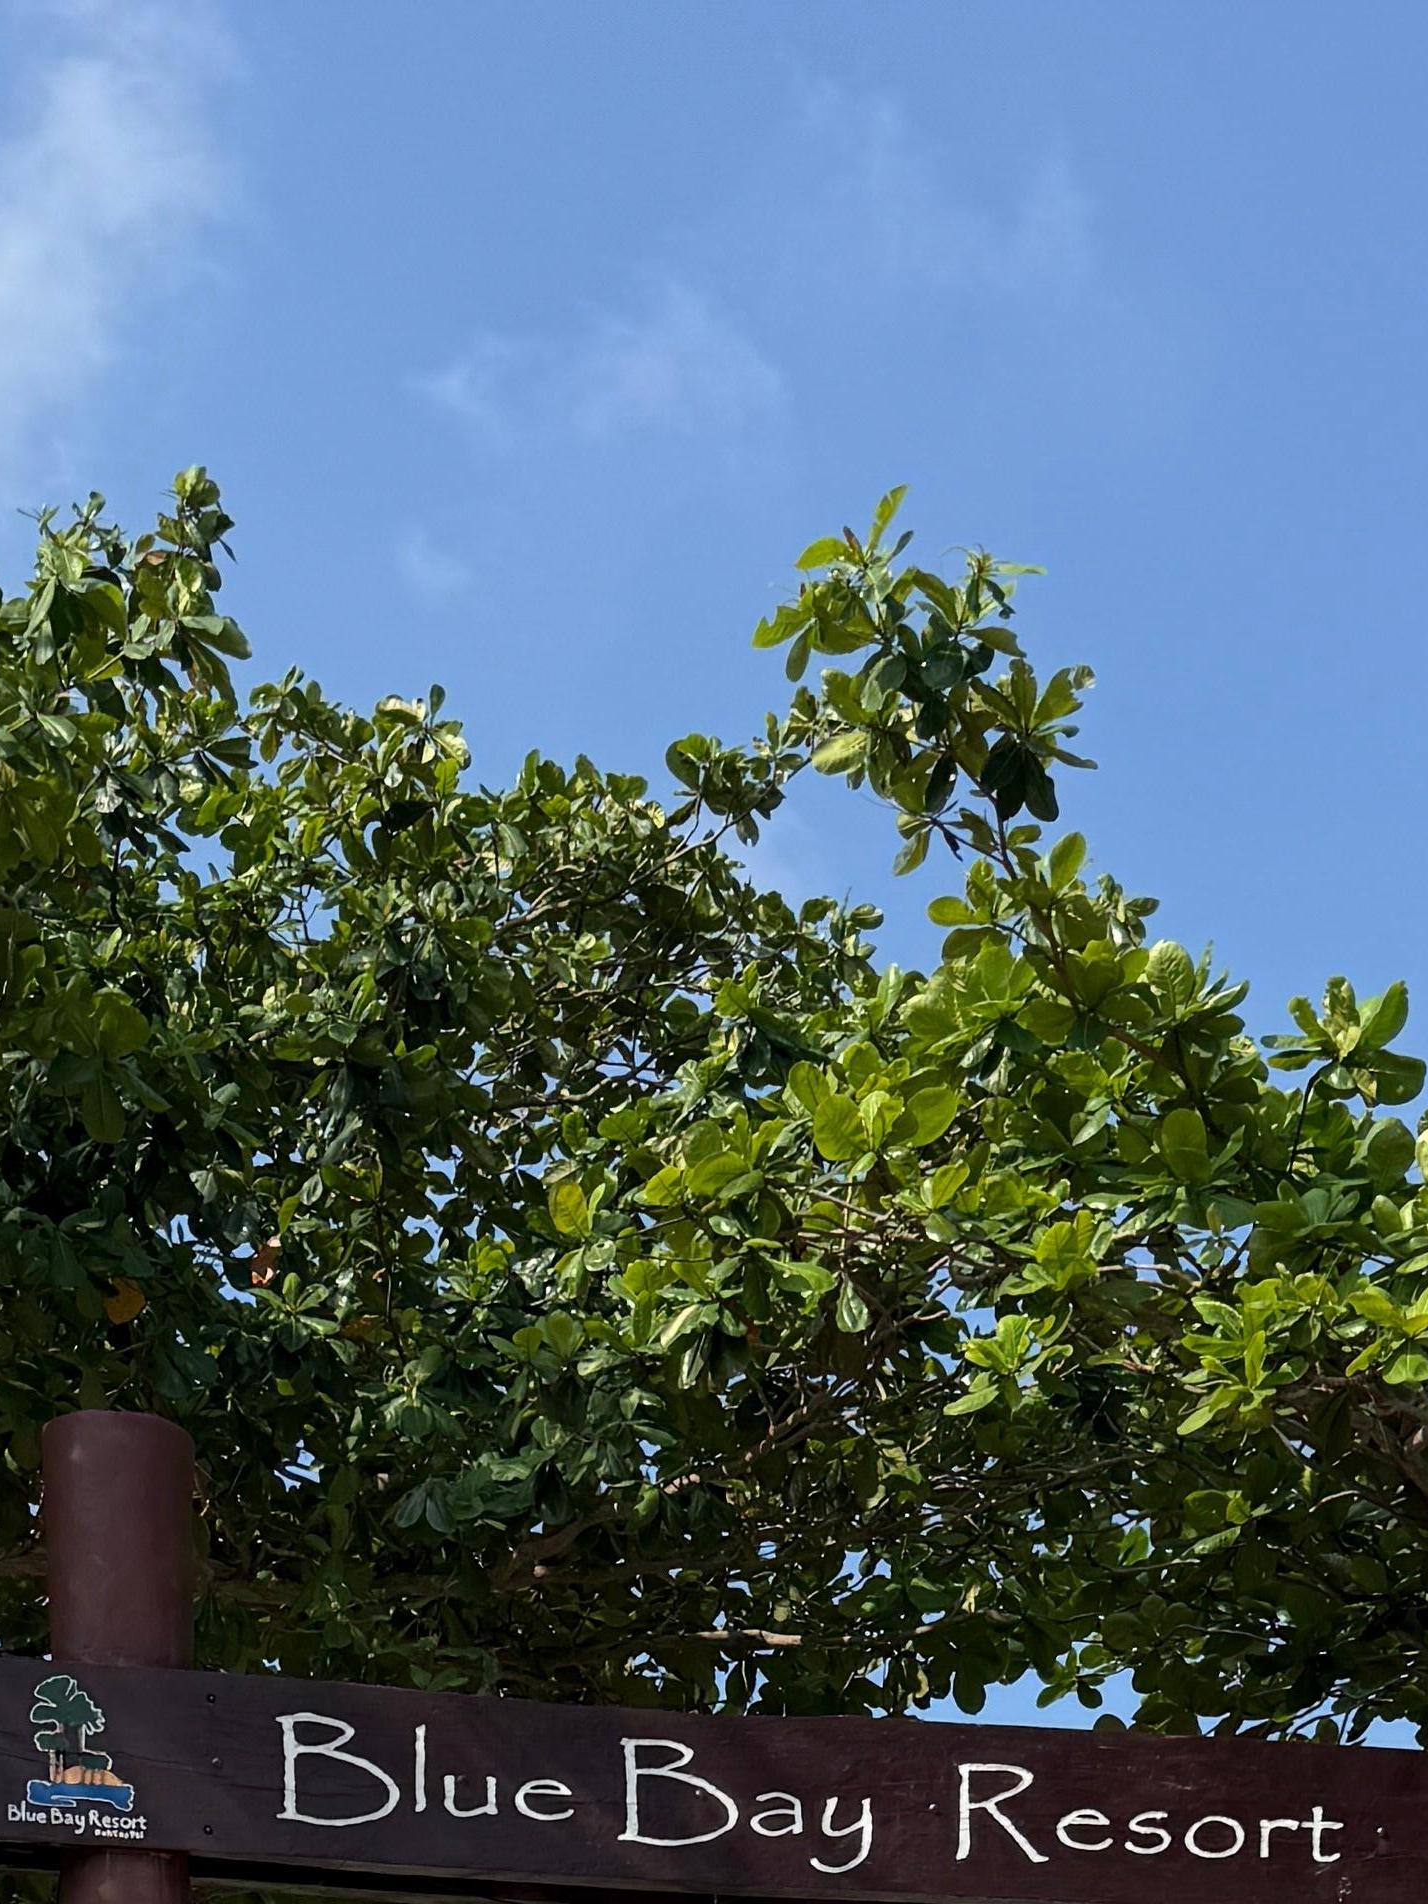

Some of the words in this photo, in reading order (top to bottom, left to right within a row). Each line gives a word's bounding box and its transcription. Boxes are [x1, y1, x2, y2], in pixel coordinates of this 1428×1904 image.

[8, 1800, 47, 1823] Blue
[51, 1808, 85, 1834] Bay
[88, 1809, 147, 1830] Resort
[276, 1713, 574, 1826] Blue
[617, 1738, 872, 1873] Bay
[956, 1763, 1343, 1862] Resort
